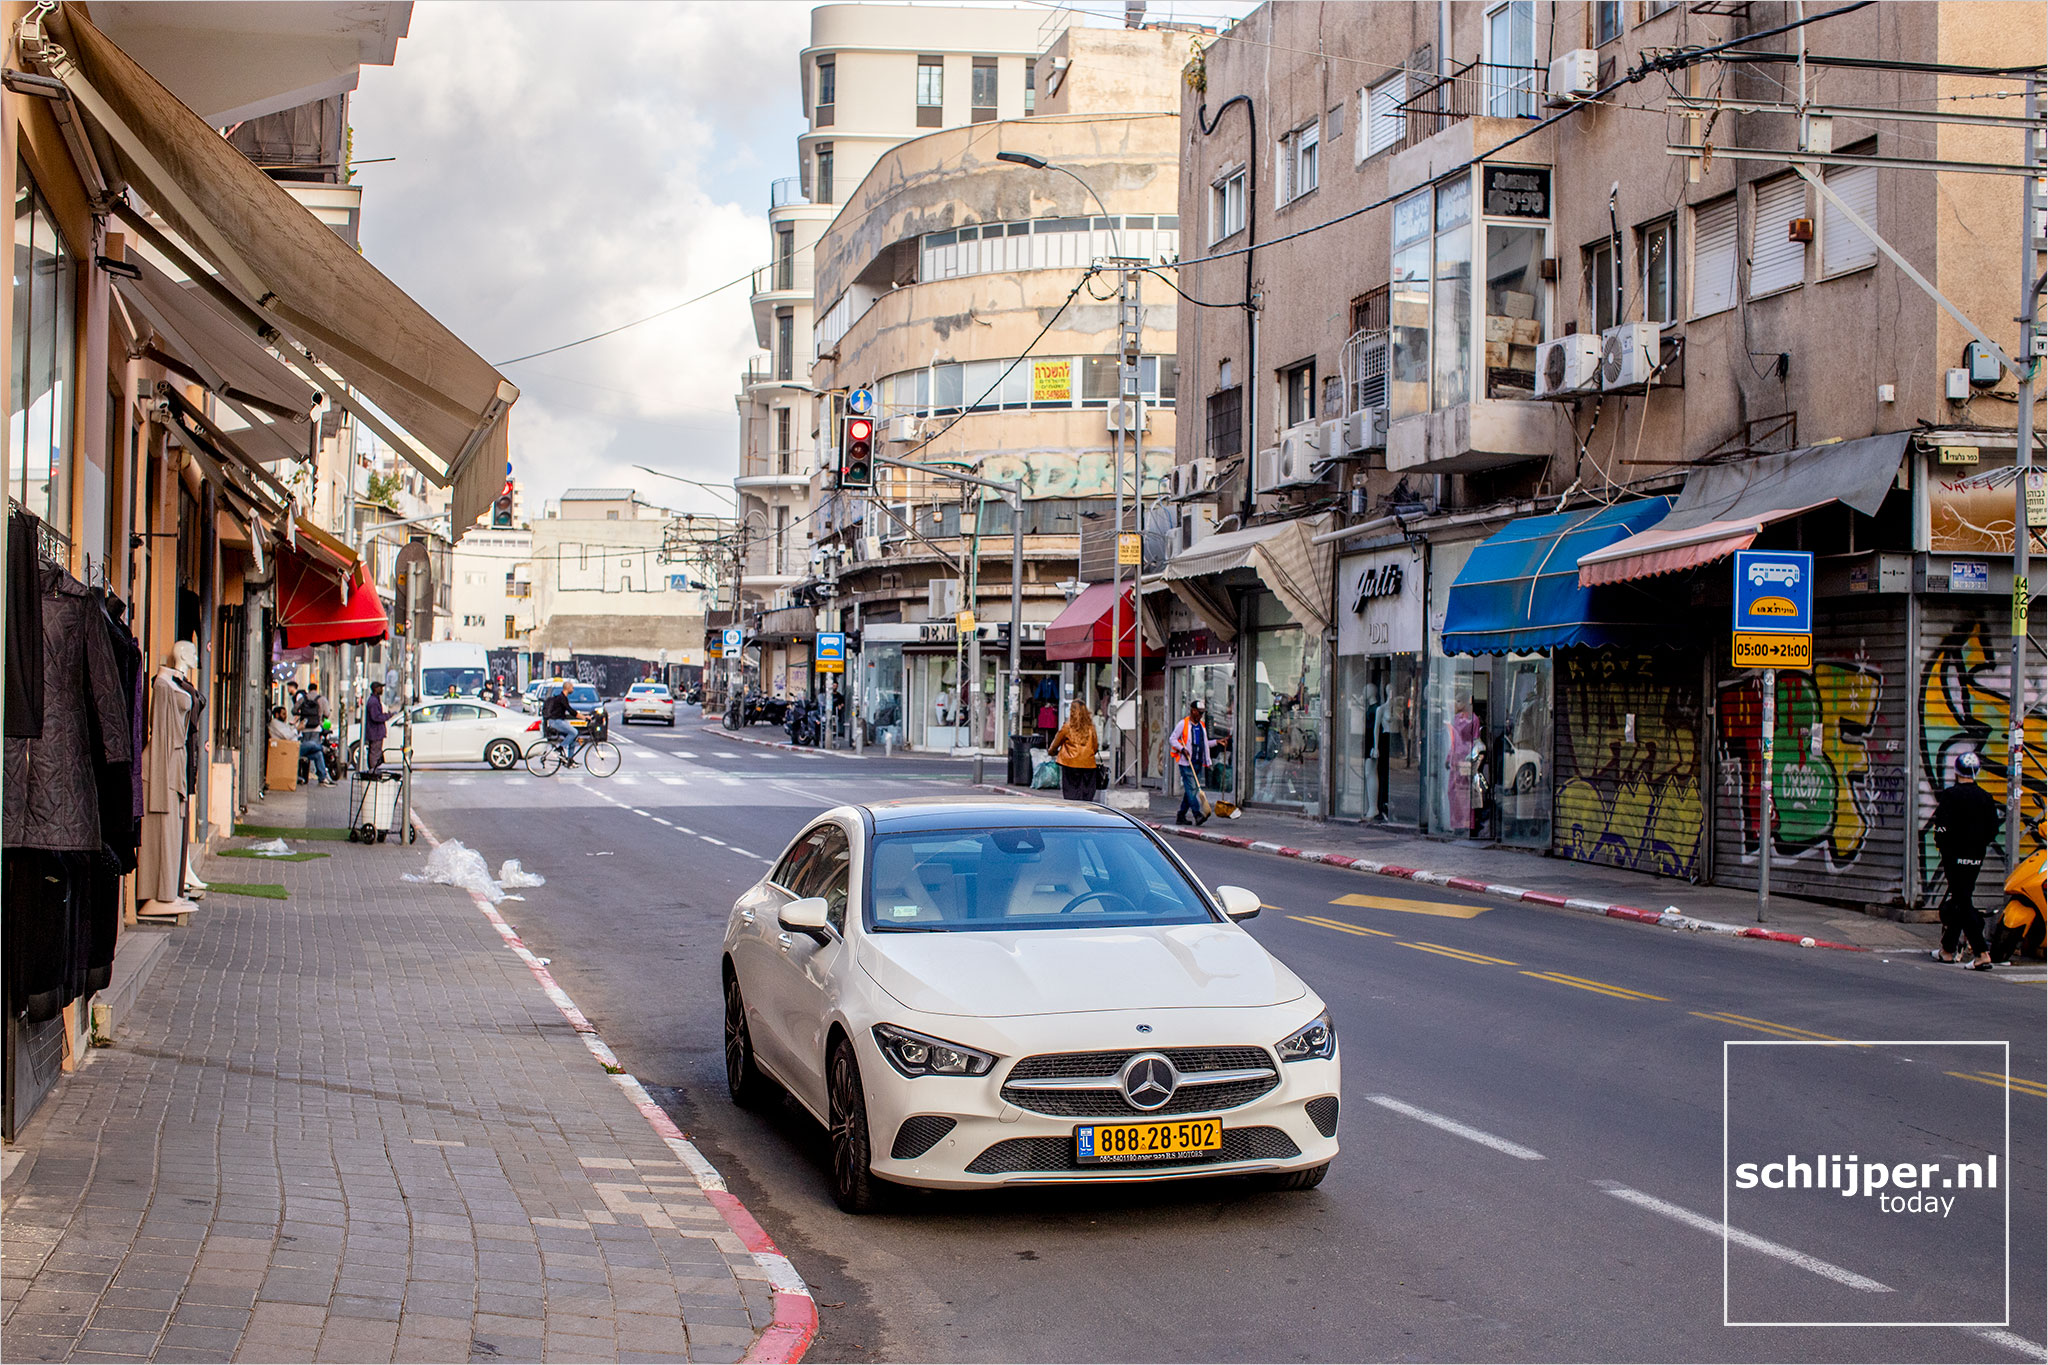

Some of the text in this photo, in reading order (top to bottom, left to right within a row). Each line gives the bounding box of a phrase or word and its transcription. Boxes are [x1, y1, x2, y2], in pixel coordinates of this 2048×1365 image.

[1034, 361, 1070, 379] להשכרה
[1944, 450, 1949, 460] 1
[1737, 643, 1808, 657] 05:00 21:00
[1957, 858, 1981, 866] REPLAY
